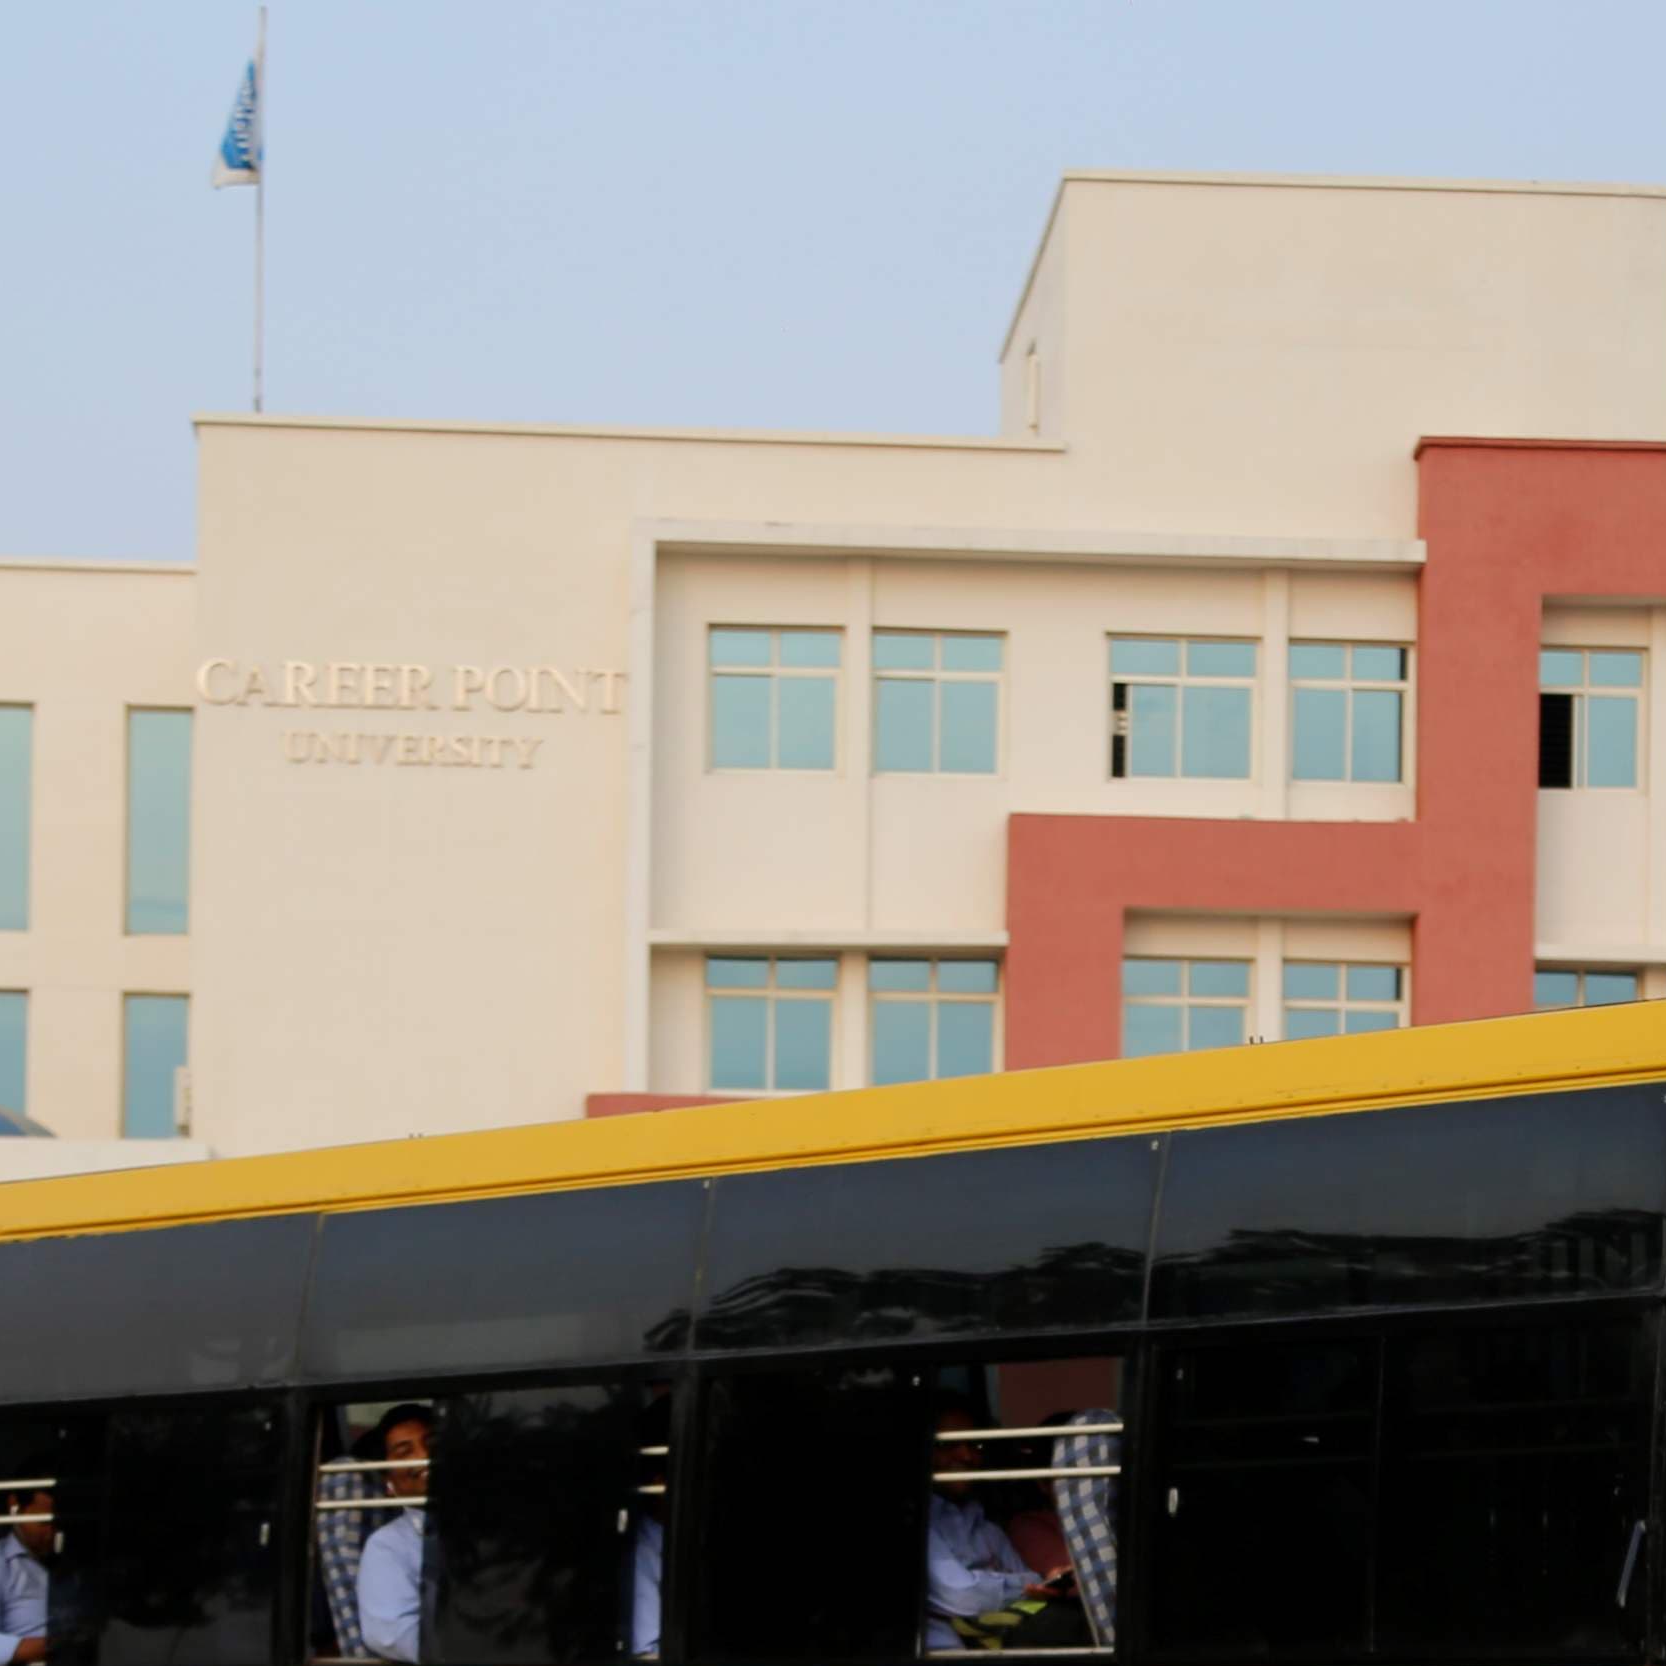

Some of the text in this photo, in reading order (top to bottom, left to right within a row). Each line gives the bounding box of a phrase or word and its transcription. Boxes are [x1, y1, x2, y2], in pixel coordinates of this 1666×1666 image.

[196, 657, 629, 715] CAREER POINT
[281, 730, 543, 768] UNIVERSITY
